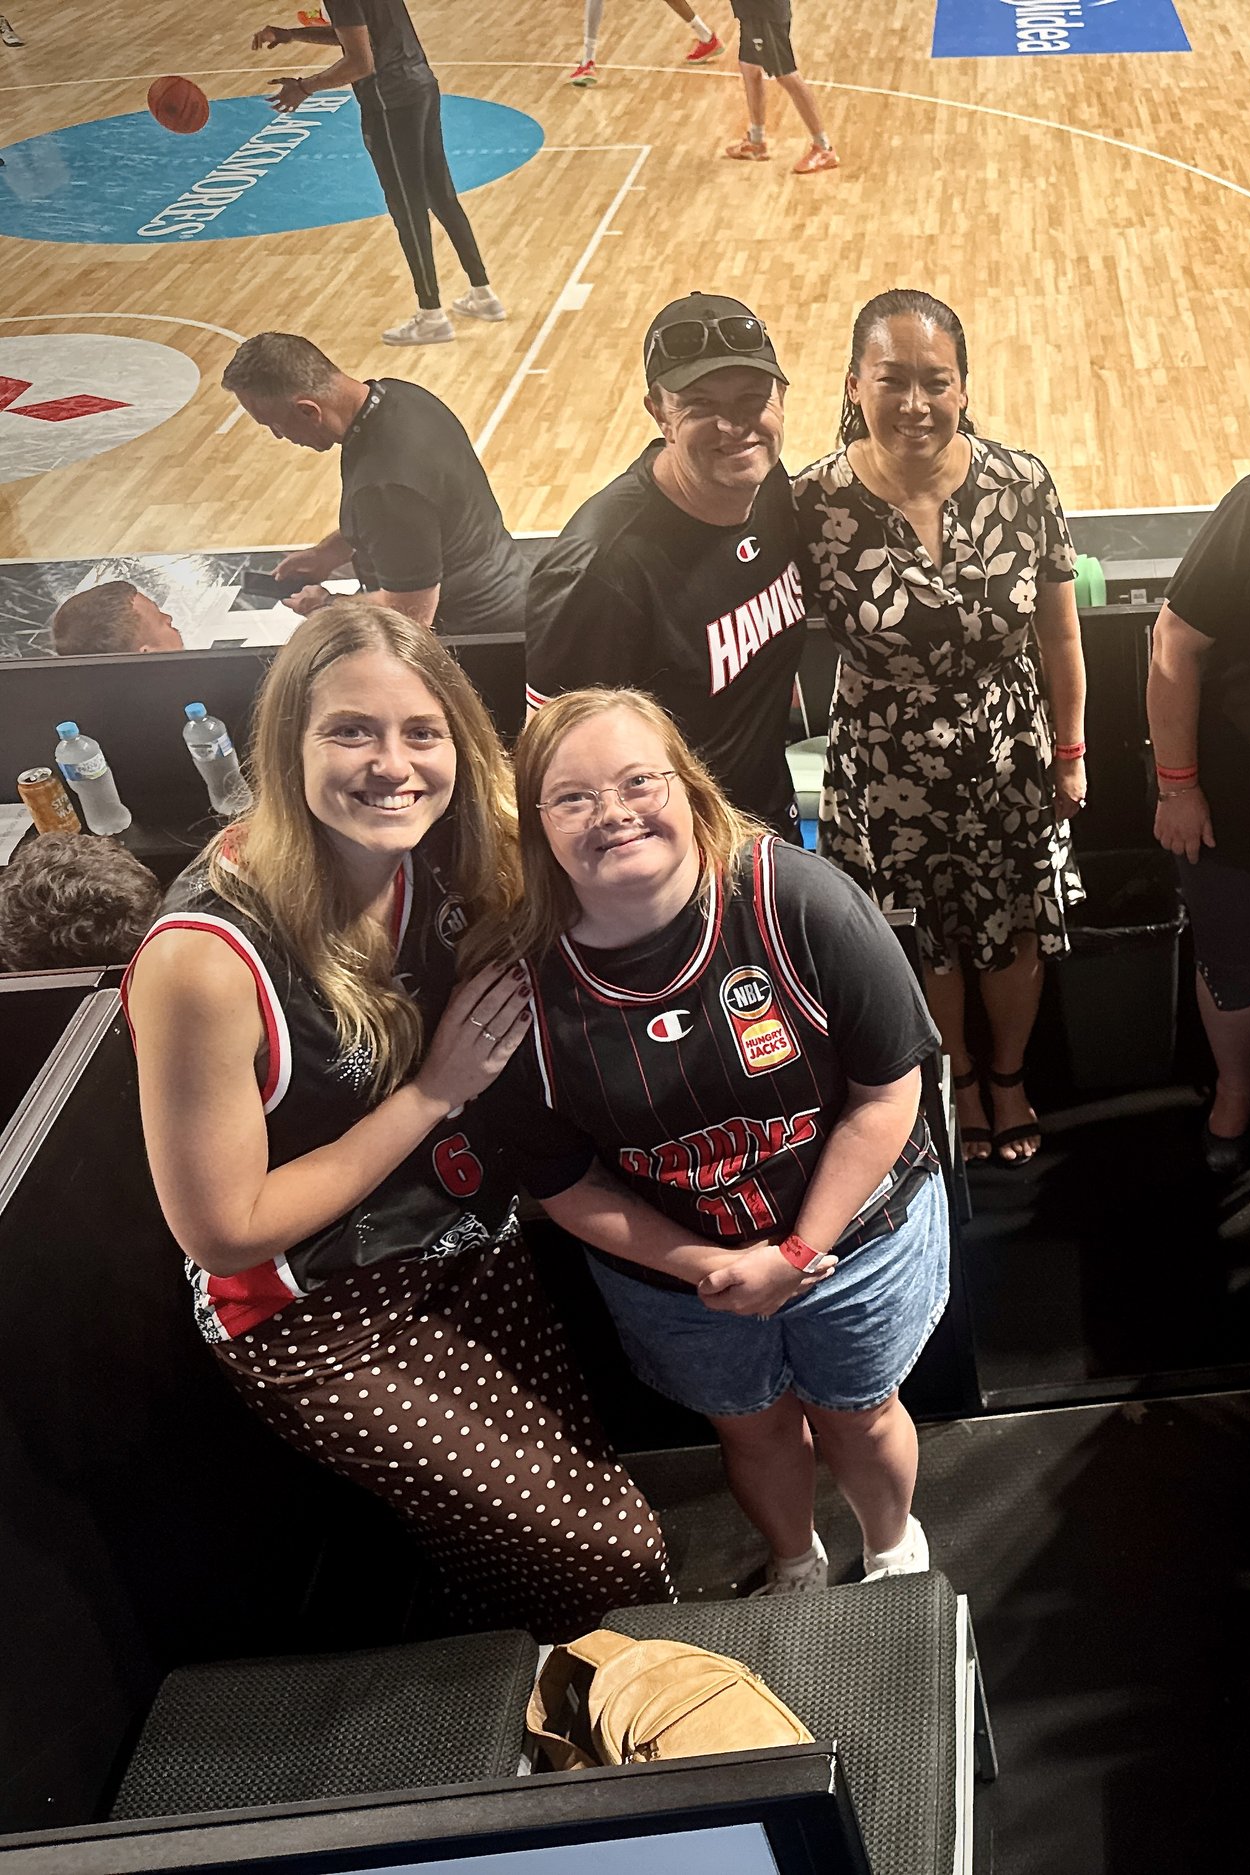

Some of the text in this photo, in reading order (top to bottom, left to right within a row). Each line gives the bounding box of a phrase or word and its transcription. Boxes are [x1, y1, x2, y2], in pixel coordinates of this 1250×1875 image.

[137, 96, 351, 237] BLACKMORES
[706, 561, 806, 697] HAWKS
[732, 981, 766, 1009] NBL
[745, 1028, 783, 1049] HUNGRY
[432, 1132, 484, 1198] 6
[696, 1176, 777, 1236] 11
